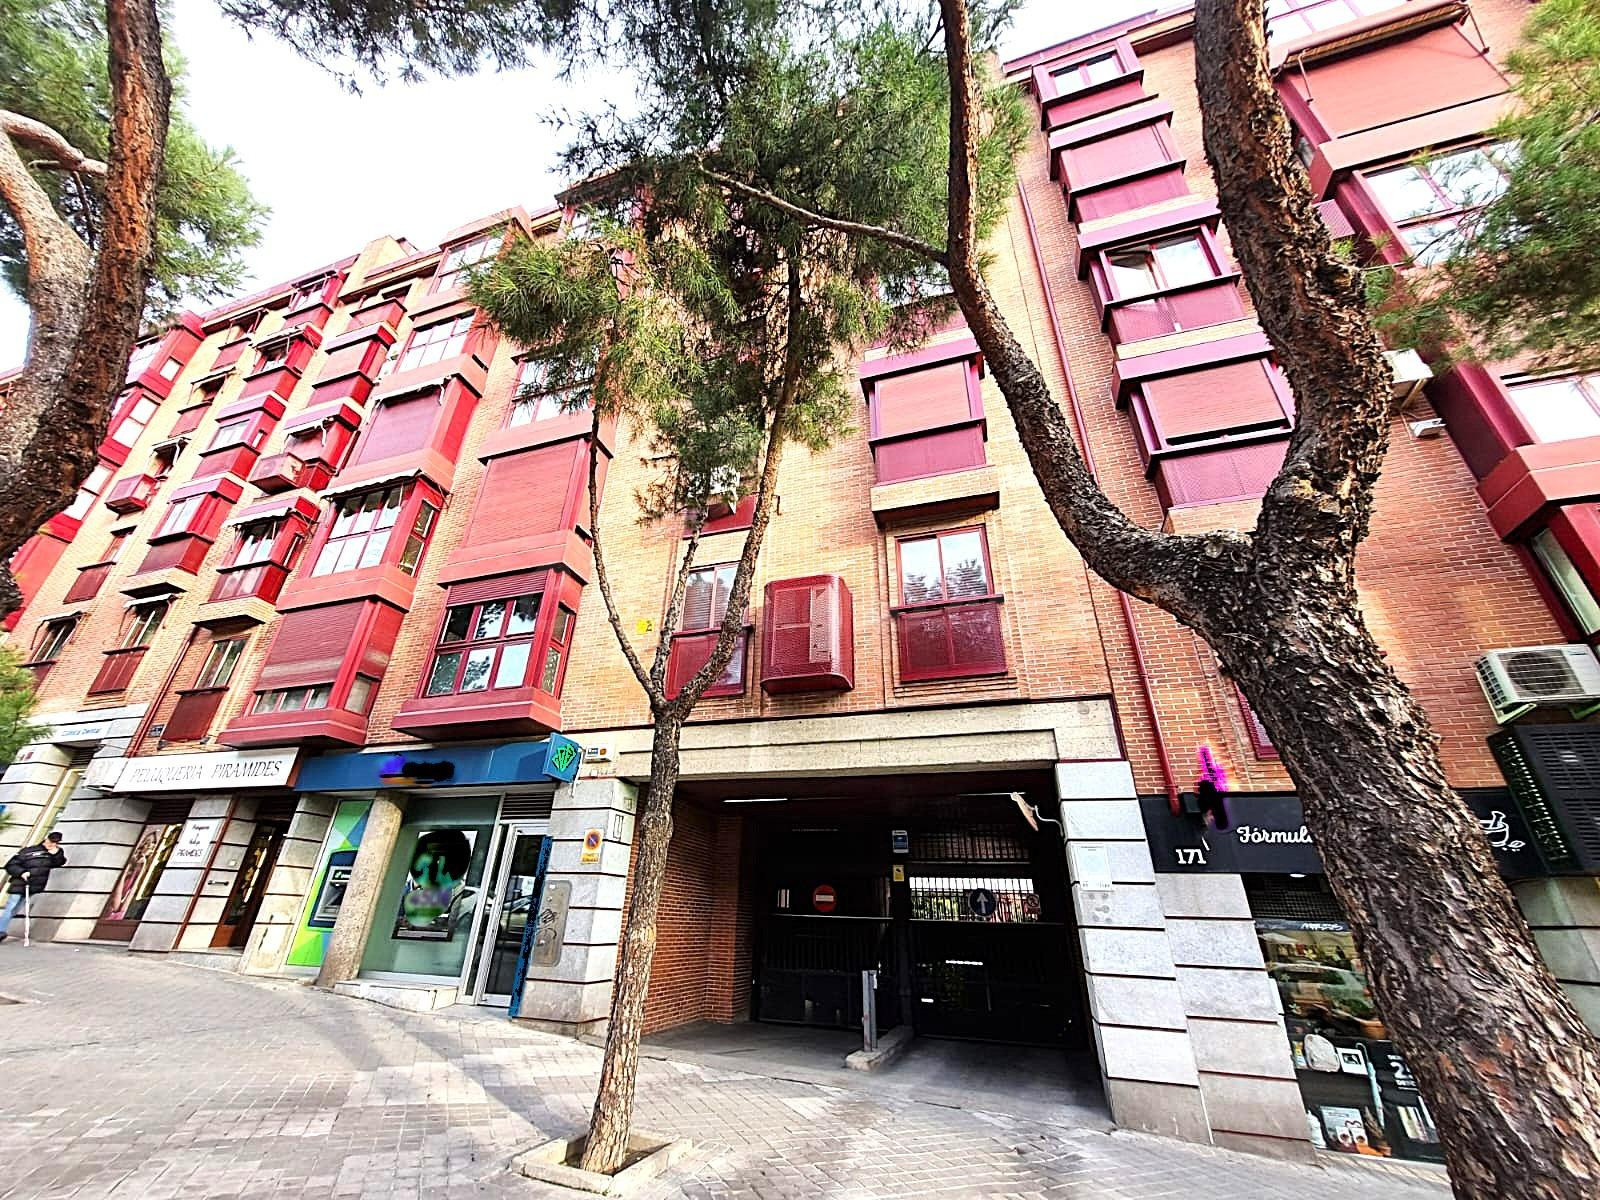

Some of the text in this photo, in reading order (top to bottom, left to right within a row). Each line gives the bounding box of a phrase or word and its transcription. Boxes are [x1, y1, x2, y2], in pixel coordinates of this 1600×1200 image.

[129, 760, 283, 784] PELUQUERIA PIRAMIDES
[1175, 849, 1207, 864] 171
